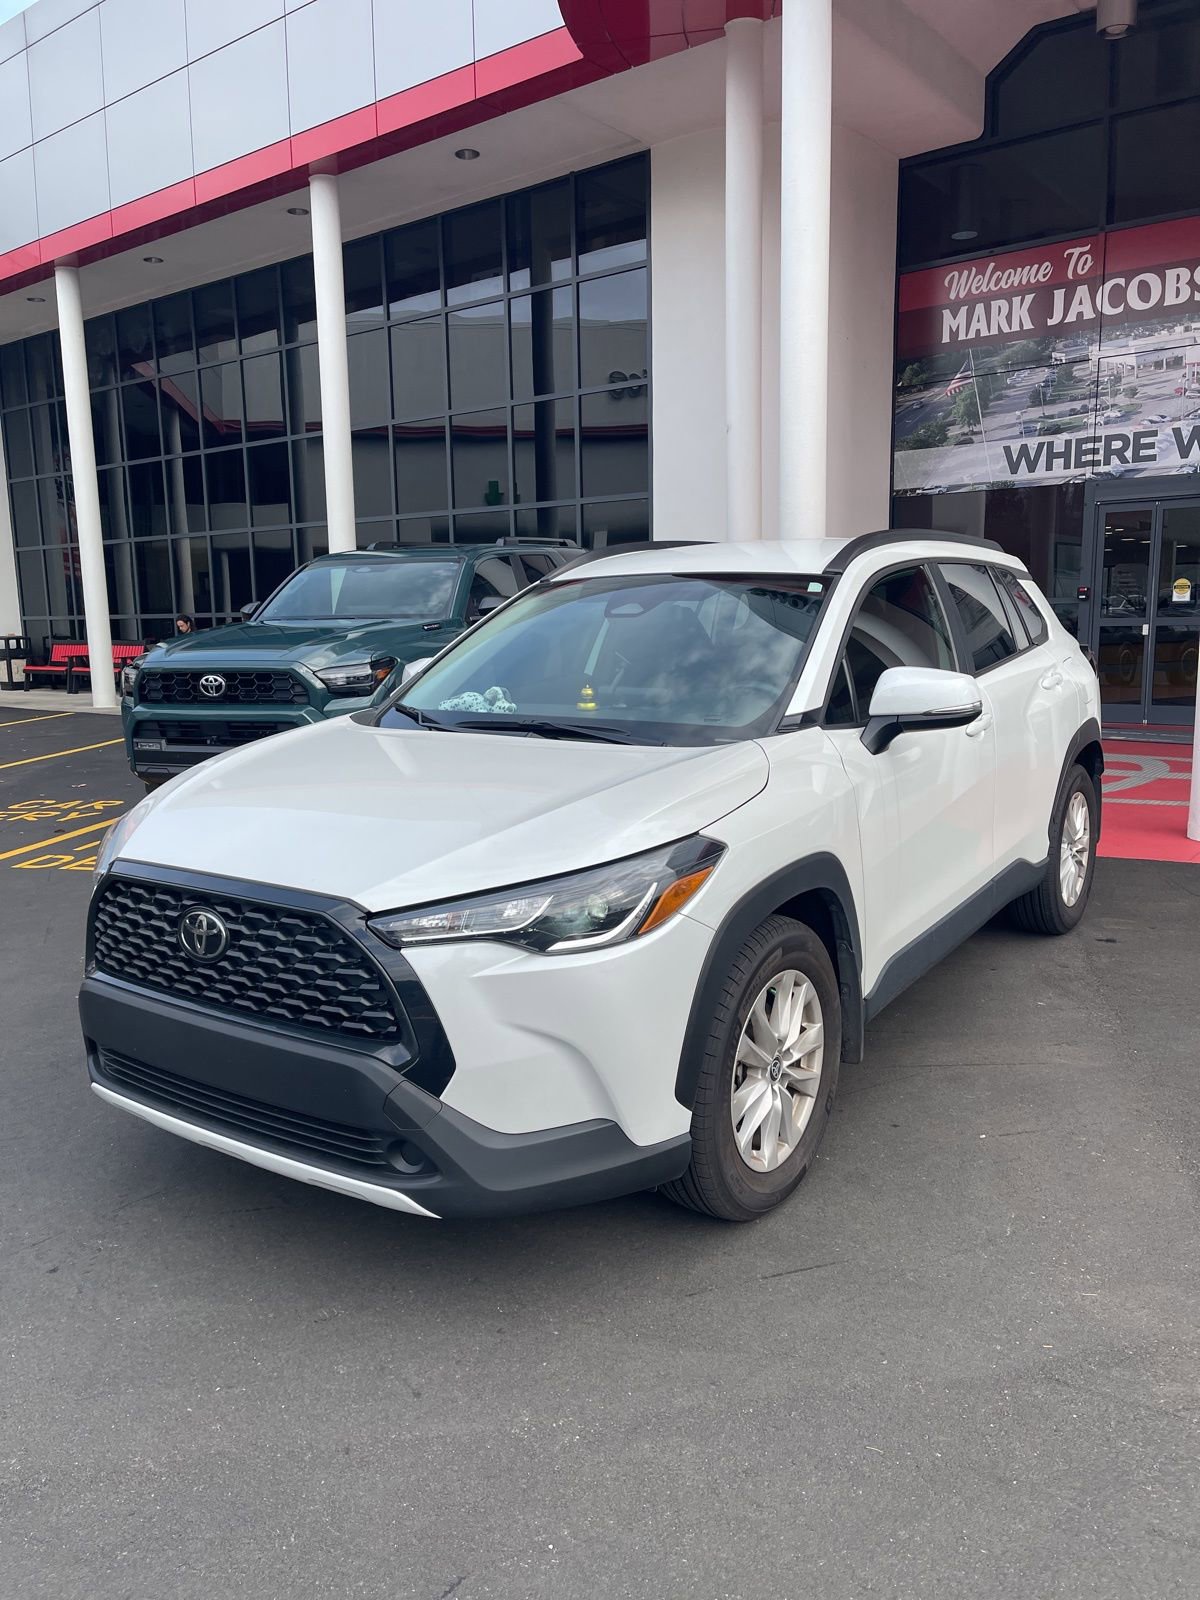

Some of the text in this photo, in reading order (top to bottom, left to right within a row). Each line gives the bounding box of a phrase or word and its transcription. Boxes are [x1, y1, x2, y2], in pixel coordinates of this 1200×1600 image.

[944, 243, 1094, 300] Welcome To
[941, 265, 1200, 344] MARK JACOB
[1003, 429, 1158, 475] WHERE
[7, 800, 124, 810] CAR
